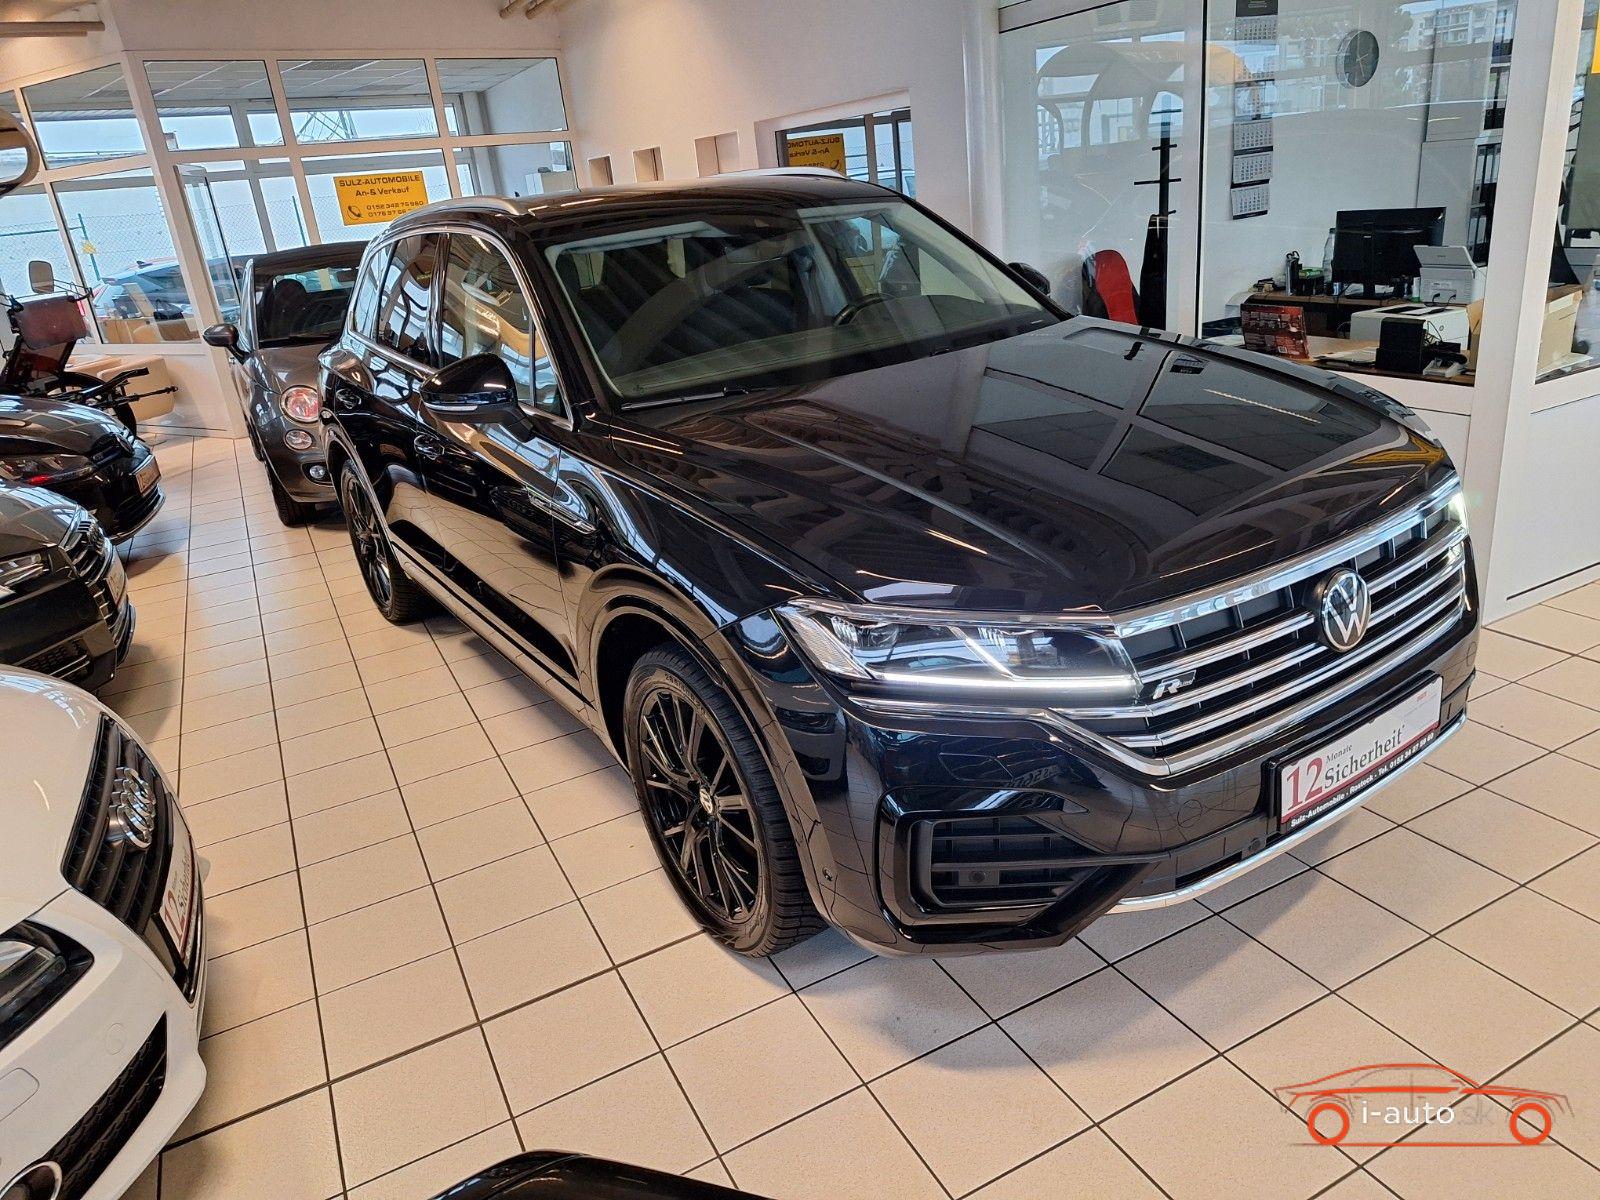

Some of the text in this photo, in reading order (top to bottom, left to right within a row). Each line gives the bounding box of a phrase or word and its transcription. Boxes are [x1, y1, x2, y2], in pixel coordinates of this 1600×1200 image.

[339, 175, 421, 187] SULZ-AUTOMOBILE
[378, 186, 410, 195] Verkauf
[1325, 744, 1353, 764] Monate
[1286, 758, 1324, 811] 12
[1291, 793, 1345, 828] Sulz-Automobile
